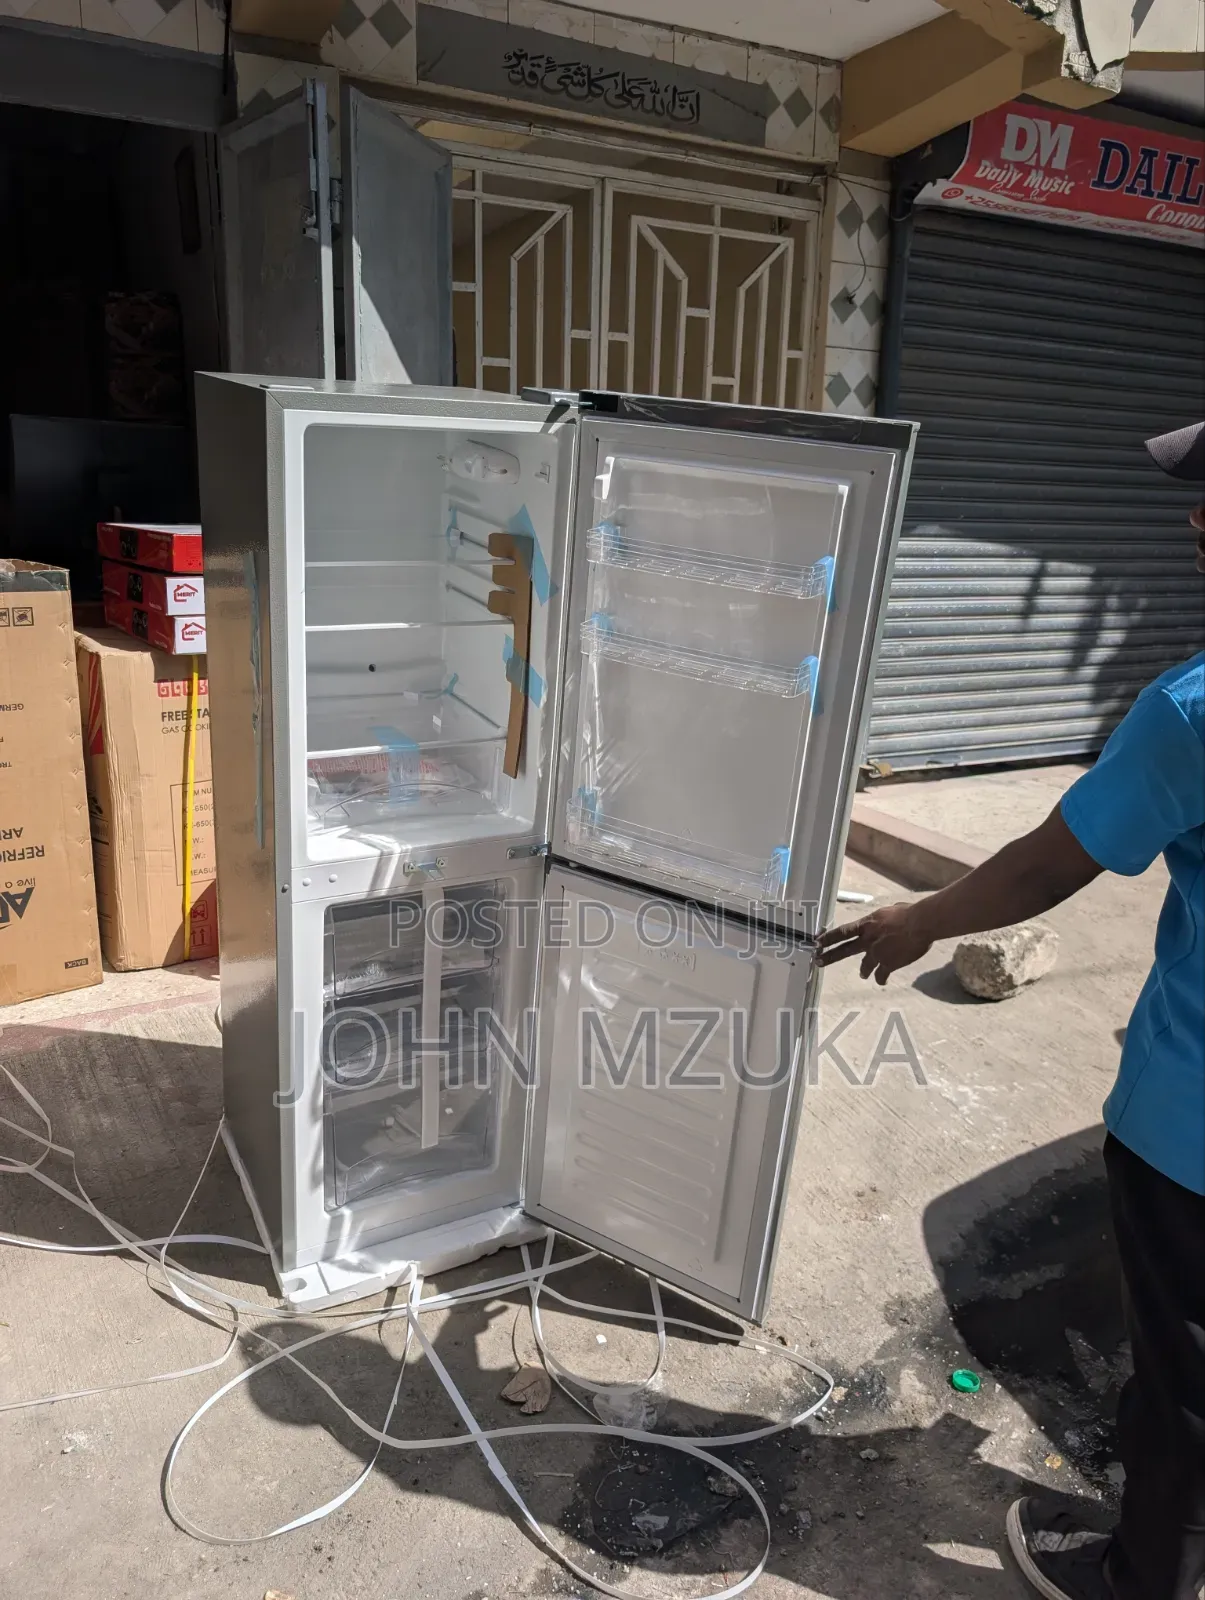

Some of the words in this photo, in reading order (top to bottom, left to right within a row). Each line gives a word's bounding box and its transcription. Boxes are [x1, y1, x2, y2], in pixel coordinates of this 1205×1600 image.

[1000, 113, 1075, 171] DM
[1024, 166, 1076, 196] Music
[1090, 138, 1205, 207] DAIL
[161, 725, 181, 736] GAS
[17, 877, 36, 888] live
[66, 959, 87, 968] BACK
